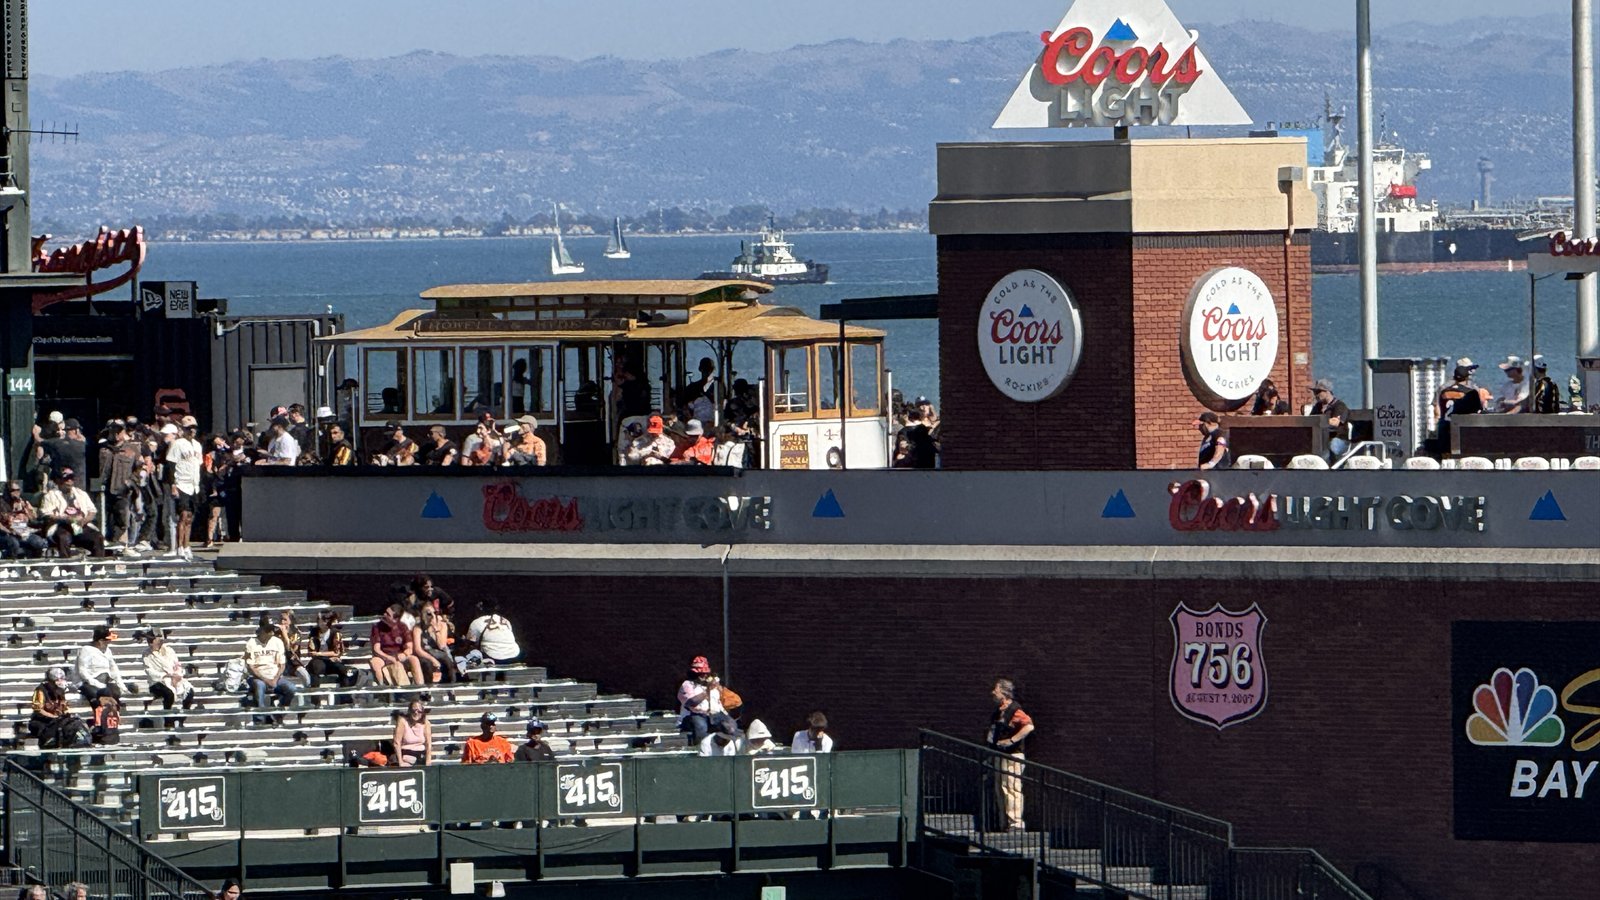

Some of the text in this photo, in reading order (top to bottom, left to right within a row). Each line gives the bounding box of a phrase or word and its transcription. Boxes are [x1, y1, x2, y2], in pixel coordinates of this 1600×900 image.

[1040, 27, 1204, 86] Coors
[1060, 86, 1184, 120] LIGHT
[993, 279, 1058, 304] COLD AS THE
[1206, 279, 1227, 302] COLD
[1232, 276, 1243, 285] AS
[990, 308, 1064, 345] Coors
[1202, 306, 1268, 341] Coors
[1000, 345, 1057, 365] LIGHT
[1210, 342, 1260, 362] LIGHT
[9, 377, 33, 392] 144
[1004, 377, 1050, 392] ROCKIES
[1215, 374, 1255, 390] ROCKIES
[482, 482, 583, 531] Coors
[681, 495, 772, 531] COVE
[1168, 479, 1489, 532] Coors LIGHT COVE
[1195, 621, 1244, 639] BONDS
[1184, 641, 1254, 690] 756
[1186, 693, 1220, 704] AUGUST
[1231, 693, 1255, 705] 2007
[367, 778, 417, 814] 415
[565, 771, 615, 807] 415
[760, 765, 808, 800] 415
[1510, 760, 1599, 798] BAY
[167, 785, 217, 821] 415
